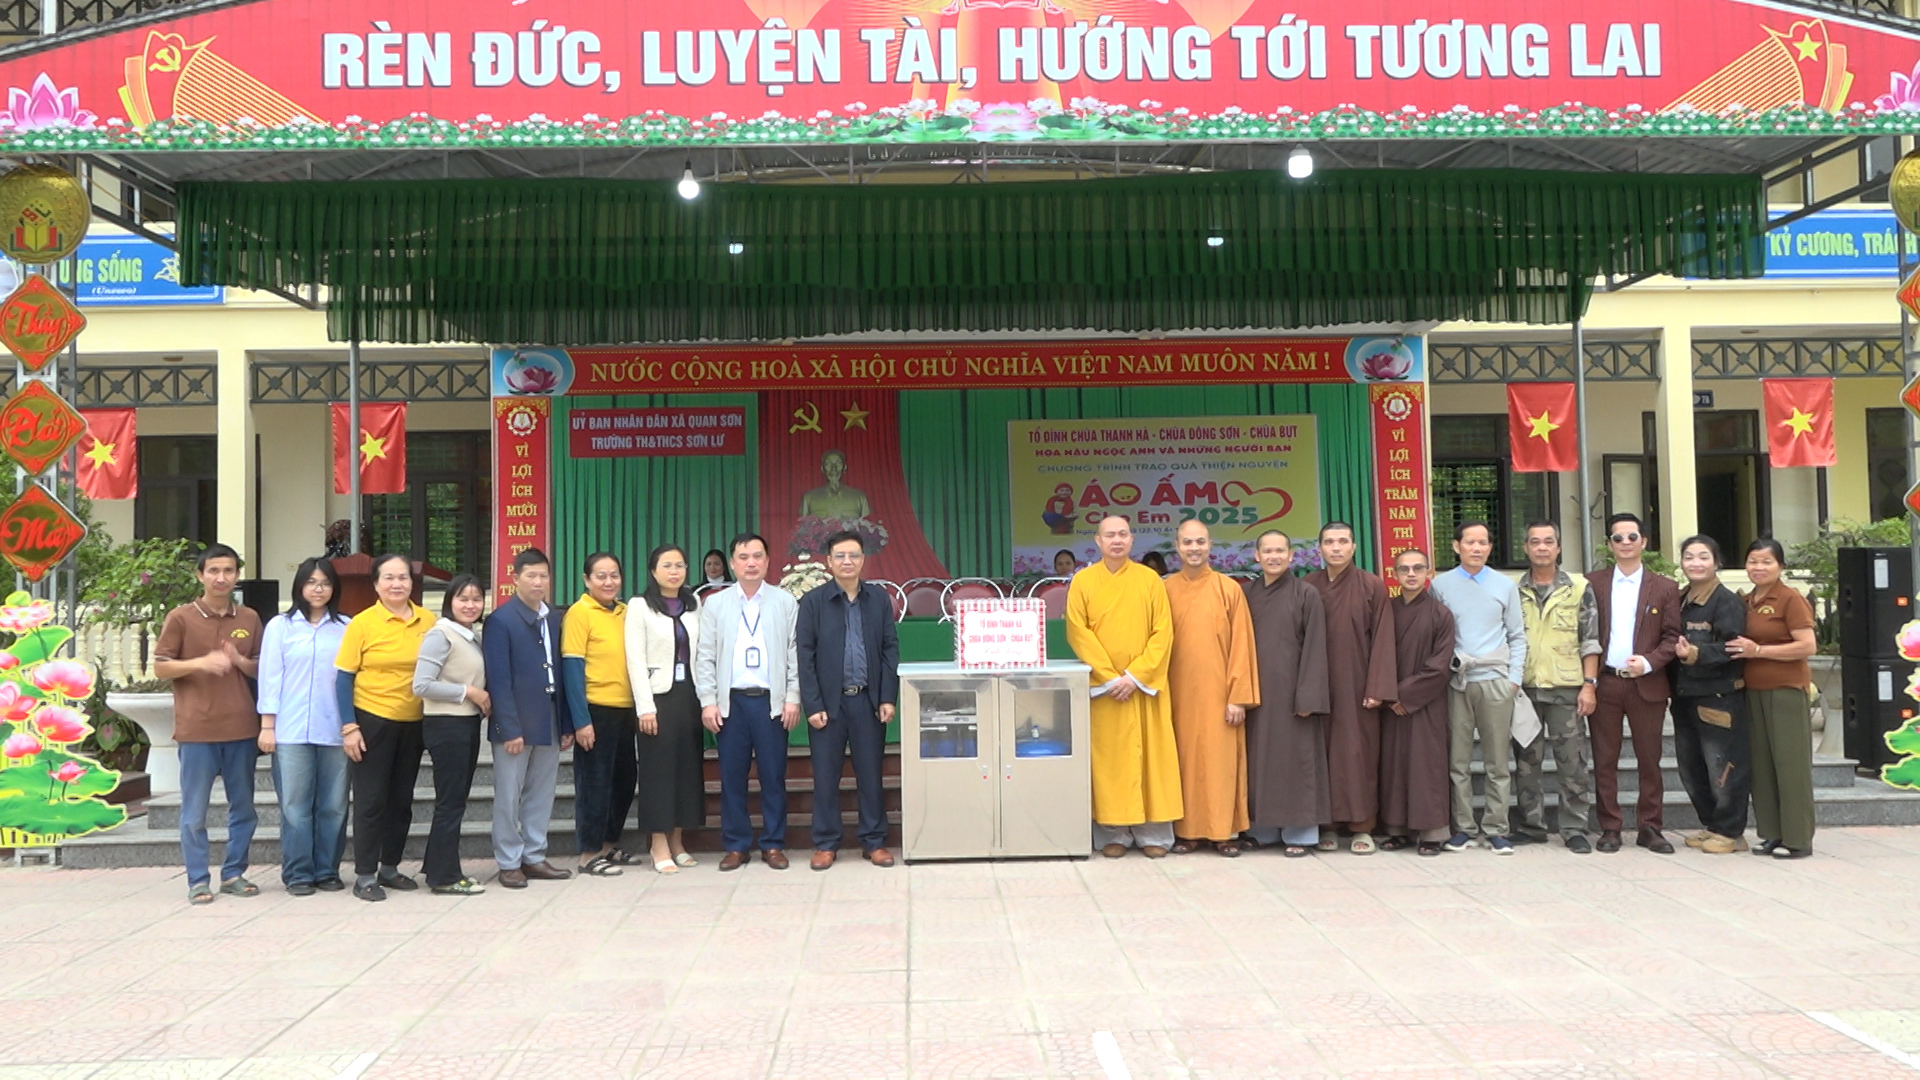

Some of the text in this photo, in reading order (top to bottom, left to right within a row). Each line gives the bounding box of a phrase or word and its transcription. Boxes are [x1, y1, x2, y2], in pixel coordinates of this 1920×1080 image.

[323, 13, 1661, 96] RÈN ĐỨC, LUYỆN TÀI, HƯỚNG TỚI TƯƠNG LAI
[98, 249, 143, 284] SỐNG
[590, 355, 663, 383] NƯỚC
[670, 355, 742, 386] CỘNG
[750, 353, 804, 380] HOÀ
[809, 353, 844, 379] XÃ
[850, 352, 897, 383] HỘI
[903, 350, 957, 378] CHỦ
[964, 351, 1047, 376] NGHĨA
[1052, 349, 1112, 379] VIỆT
[1118, 353, 1173, 374] NAM
[1180, 347, 1255, 373] MUÔN
[1262, 347, 1317, 371] NĂM
[588, 416, 611, 430] BAN
[613, 413, 644, 429] NHÂN
[646, 413, 669, 428] DÂN
[671, 412, 686, 428] XÃ
[688, 415, 717, 429] QUAN
[720, 413, 743, 428] SƠN
[1043, 428, 1068, 443] ĐÌNH
[1071, 427, 1097, 443] CHÙA
[1100, 429, 1133, 442] THANH
[1136, 426, 1149, 442] HÀ
[1159, 425, 1186, 441] CHÙA
[1219, 425, 1241, 440] SƠN
[1250, 423, 1277, 439] CHÙA
[1279, 424, 1298, 442] BỤT
[1391, 427, 1405, 442] VÌ
[515, 441, 529, 458] VÌ
[591, 433, 632, 450] TRƯỜNG
[635, 435, 683, 449] TH&THCS
[685, 433, 708, 448] SƠN
[1129, 446, 1155, 456] ANH
[1389, 448, 1409, 464] LỢI
[511, 463, 532, 480] LỢI
[1134, 462, 1167, 471] TRAO
[1389, 465, 1411, 480] ÍCH
[511, 481, 533, 497] ÍCH
[1079, 473, 1221, 507] ÁO ẤM
[1384, 485, 1418, 500] TRĂM
[506, 501, 538, 516] MƯỜI
[1137, 511, 1171, 524] Em
[1179, 506, 1259, 524] 2025
[1388, 505, 1417, 521] NĂM
[507, 521, 537, 536] NĂM
[1392, 523, 1414, 539] THÌ
